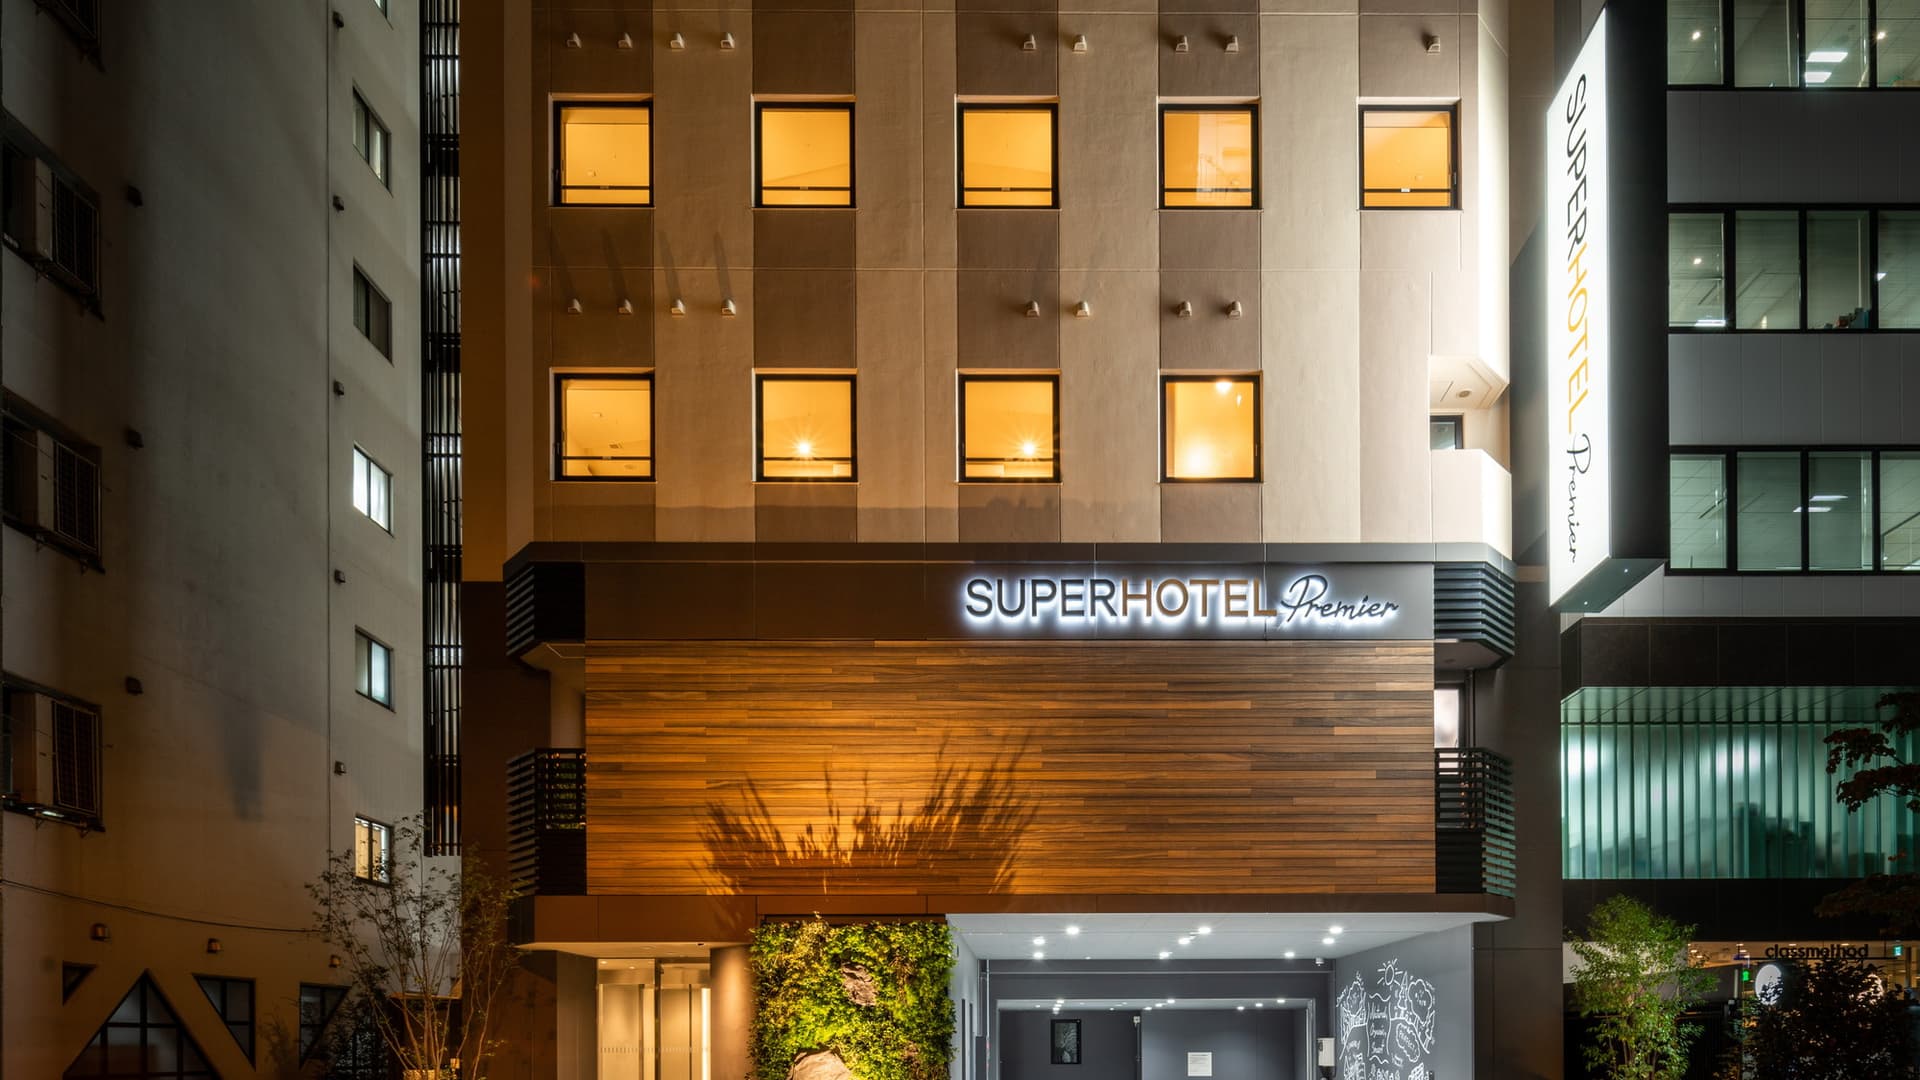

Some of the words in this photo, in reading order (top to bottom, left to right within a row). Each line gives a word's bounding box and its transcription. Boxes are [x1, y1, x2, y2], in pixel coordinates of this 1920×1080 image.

[1566, 433, 1591, 563] Premier
[1280, 574, 1399, 622] Premier
[1764, 943, 1869, 958] classmethod
